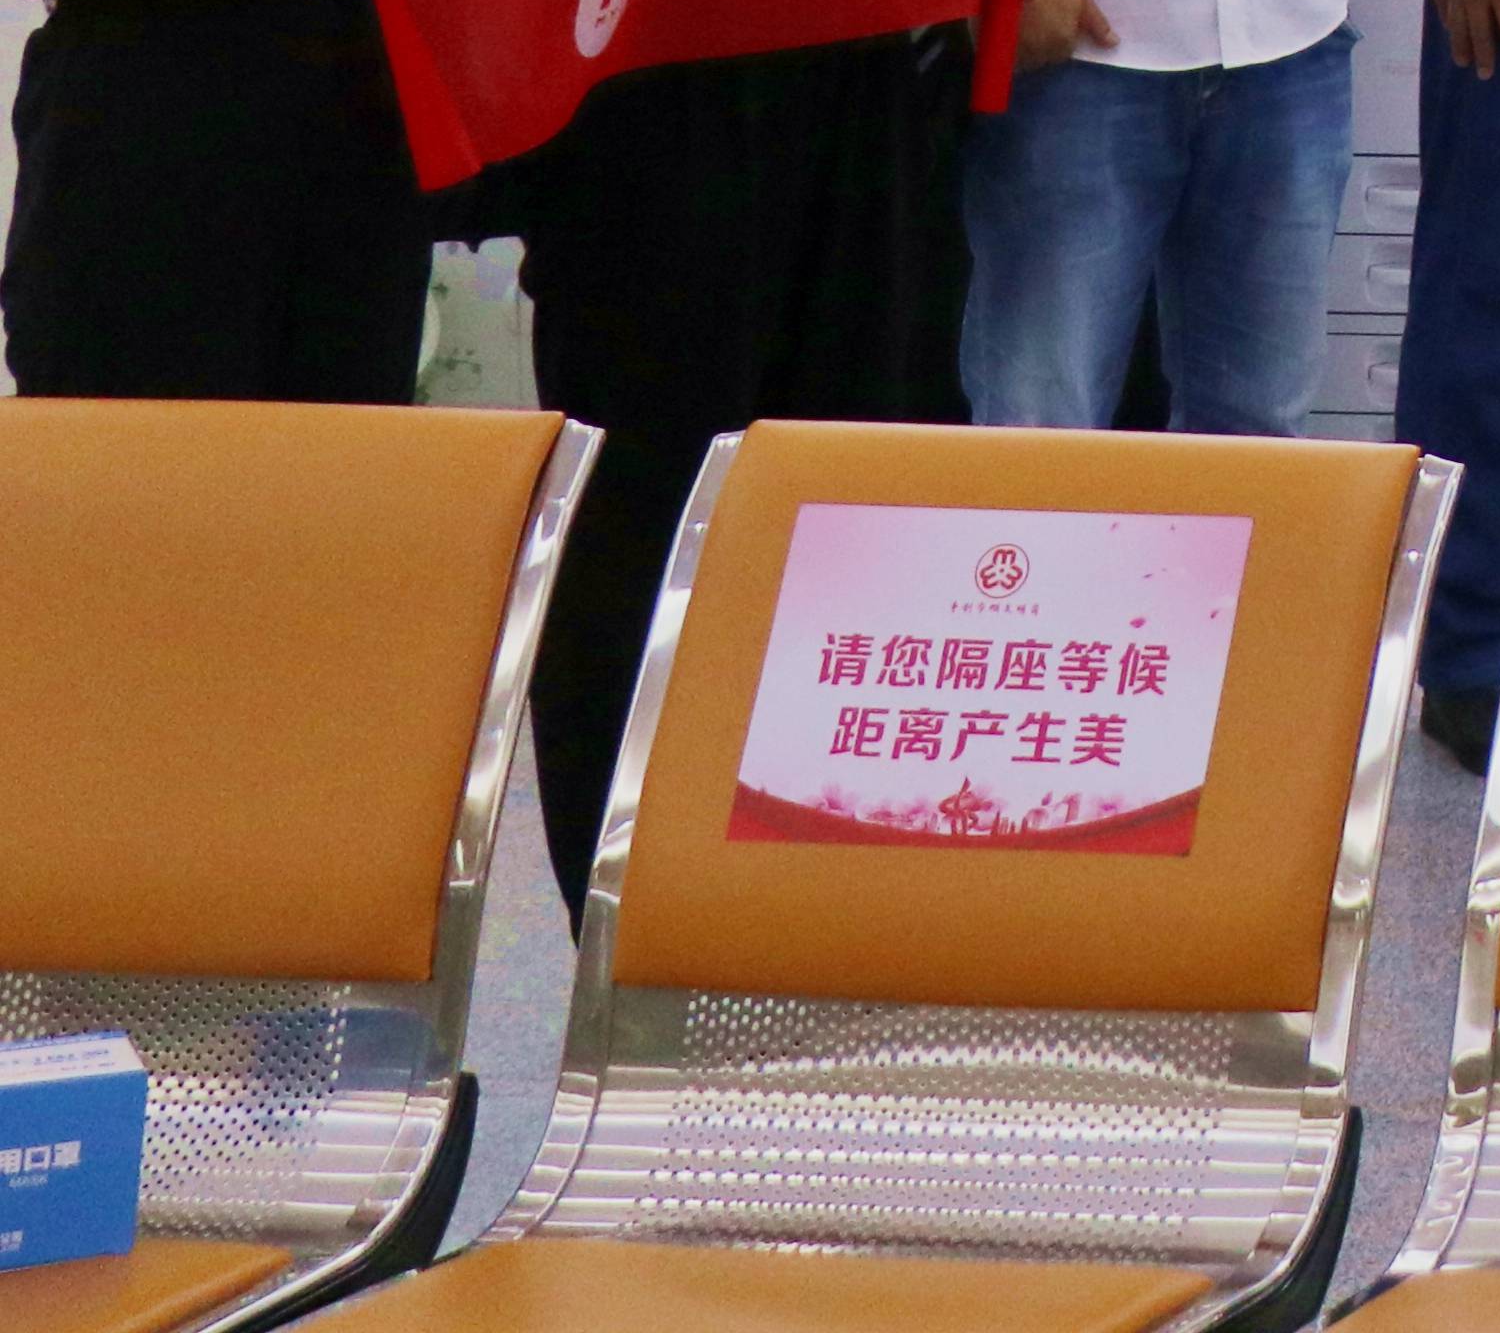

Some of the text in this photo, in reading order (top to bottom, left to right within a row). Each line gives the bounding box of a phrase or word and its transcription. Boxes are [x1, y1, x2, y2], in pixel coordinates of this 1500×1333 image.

[816, 631, 1171, 697] 请您隔座等候
[828, 706, 1128, 767] 距离产生美
